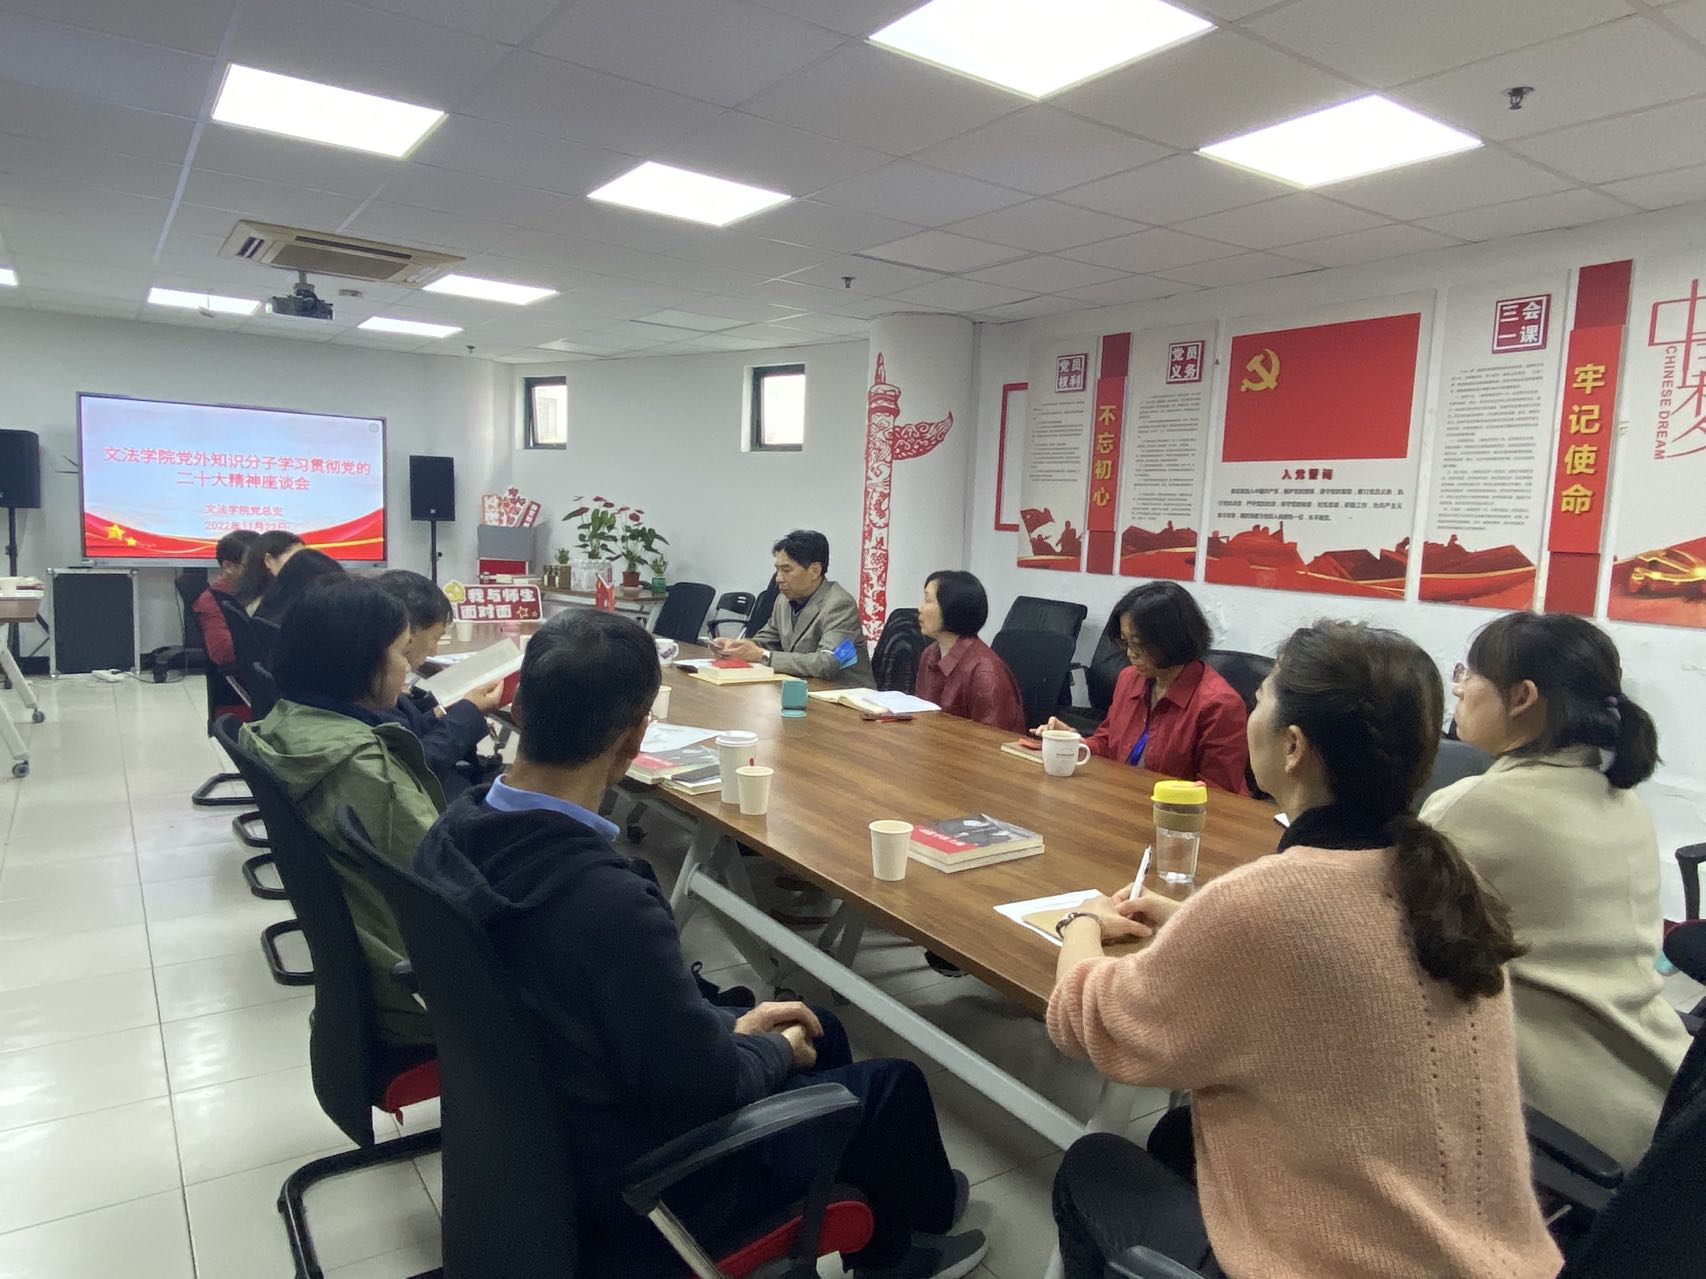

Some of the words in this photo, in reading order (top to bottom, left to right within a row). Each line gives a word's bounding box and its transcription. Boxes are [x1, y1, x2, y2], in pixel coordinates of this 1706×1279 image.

[1500, 301, 1541, 322] 三会
[1498, 325, 1539, 343] 一课
[1659, 345, 1677, 407] CHINESE
[1560, 363, 1606, 515] 牢记使命
[1653, 410, 1671, 460] DREAM
[104, 446, 371, 476] 文法学院党外知识分子学习贯彻党的
[1093, 404, 1117, 507] 不忘初心
[176, 470, 311, 492] 二十大精神座谈会
[460, 604, 512, 619] 面对面
